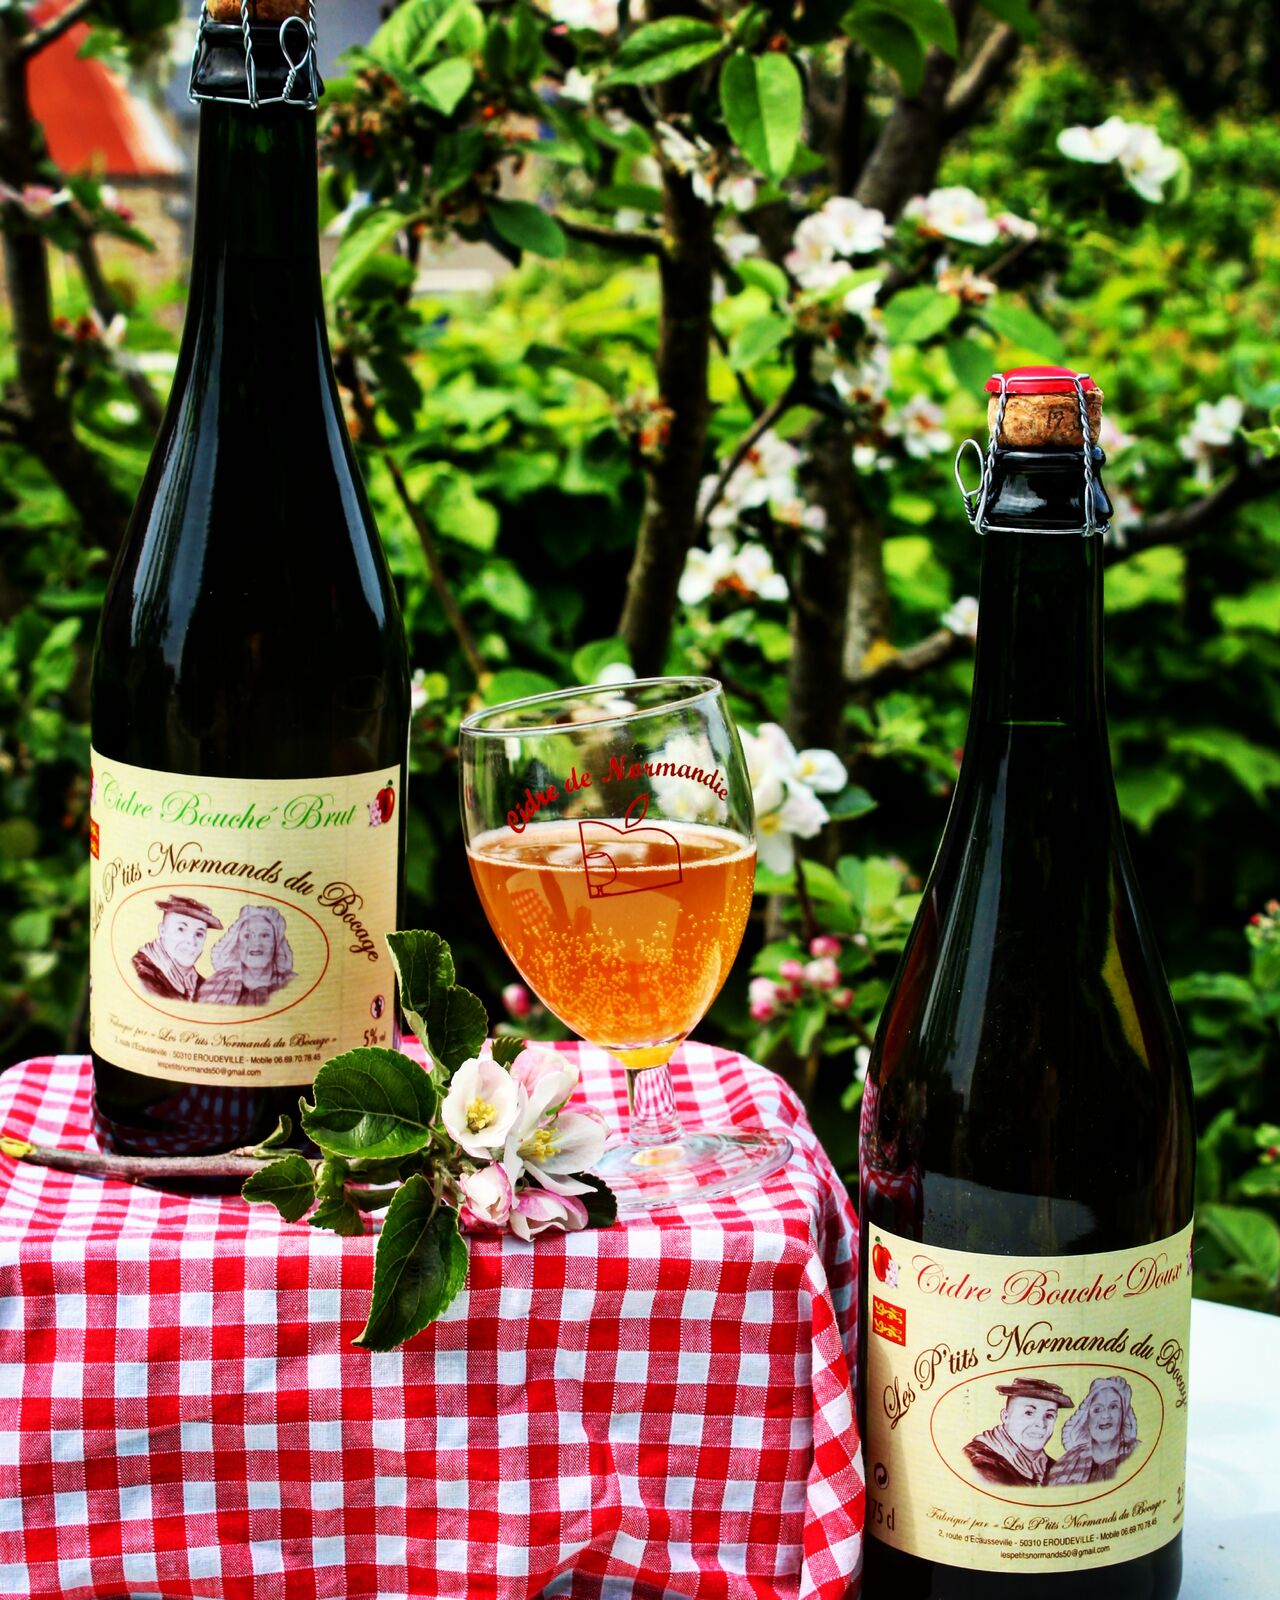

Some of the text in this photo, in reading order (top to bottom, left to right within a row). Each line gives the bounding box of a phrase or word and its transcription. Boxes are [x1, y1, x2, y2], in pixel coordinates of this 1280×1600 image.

[101, 771, 357, 831] Cidre Bouché Brut
[508, 755, 729, 834] Cidre de Normandie
[102, 856, 143, 903] P'tits
[147, 841, 284, 884] Normands
[284, 871, 315, 896] du
[317, 881, 379, 963] Bocage
[158, 1026, 177, 1042] Les
[179, 1030, 209, 1047] P'tits
[211, 1032, 272, 1049] Normands
[272, 1037, 286, 1049] du
[289, 1032, 329, 1051] Bocage
[173, 1050, 193, 1061] 50310
[194, 1053, 245, 1064] EROUDEVILLE
[251, 1055, 273, 1065] Mobile
[911, 1252, 1183, 1306] Cidre Bouché Doux
[883, 1375, 916, 1430] Les
[914, 1342, 979, 1391] P'tits
[986, 1320, 1130, 1363] Normands
[1130, 1333, 1154, 1360] du
[871, 1498, 896, 1532] 75 cl
[925, 1506, 970, 1528] Fabriqué
[968, 1517, 989, 1531] par
[1000, 1515, 1025, 1531] Les
[1027, 1516, 1060, 1531] P'tits
[1061, 1511, 1118, 1530] Normands
[1118, 1508, 1130, 1520] du
[1131, 1500, 1161, 1517] Bocage
[945, 1532, 963, 1542] route
[1019, 1538, 1042, 1547] 50310
[1043, 1534, 1095, 1547] EROUDEVILLE
[1100, 1529, 1121, 1541] Mobile
[1000, 1544, 1111, 1560] lespetitsnormands50@gmail.com
